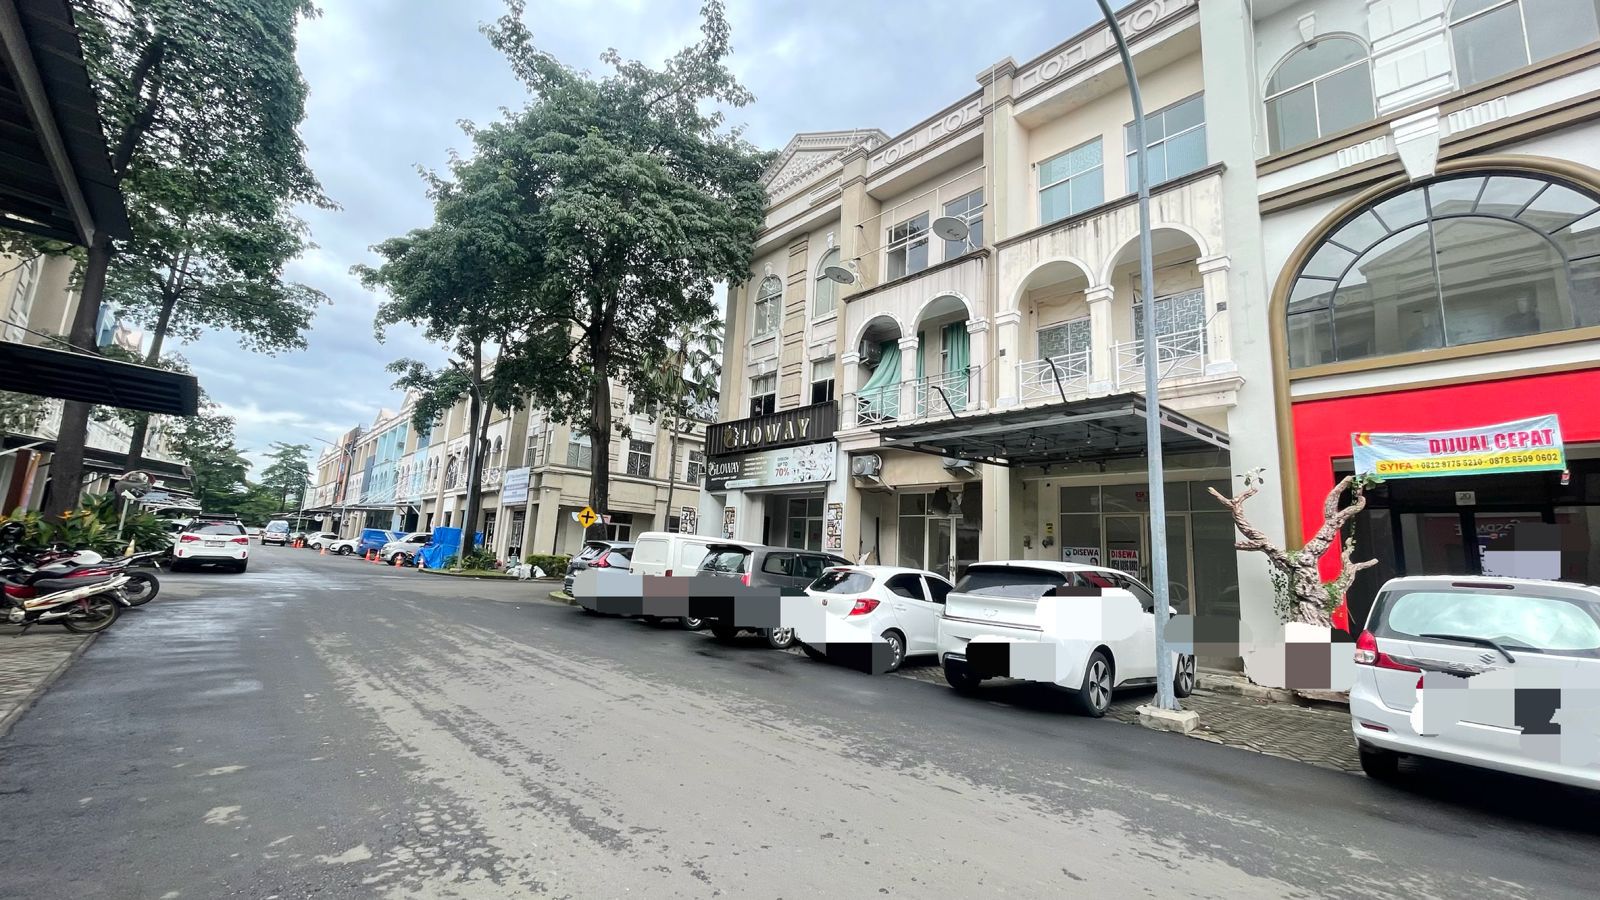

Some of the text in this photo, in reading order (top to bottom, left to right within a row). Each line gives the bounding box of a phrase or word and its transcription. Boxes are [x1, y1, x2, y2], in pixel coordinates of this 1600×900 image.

[1429, 429, 1553, 455] DIJUAL CEPAT
[1380, 462, 1412, 471] SYIFA
[1421, 461, 1440, 469] 0812
[1463, 458, 1483, 467] 5210
[1489, 456, 1510, 465] 0878
[1536, 453, 1558, 462] 0602
[776, 468, 790, 477] 70%
[1073, 548, 1099, 556] DISEWA
[1111, 550, 1137, 558] DISEWA
